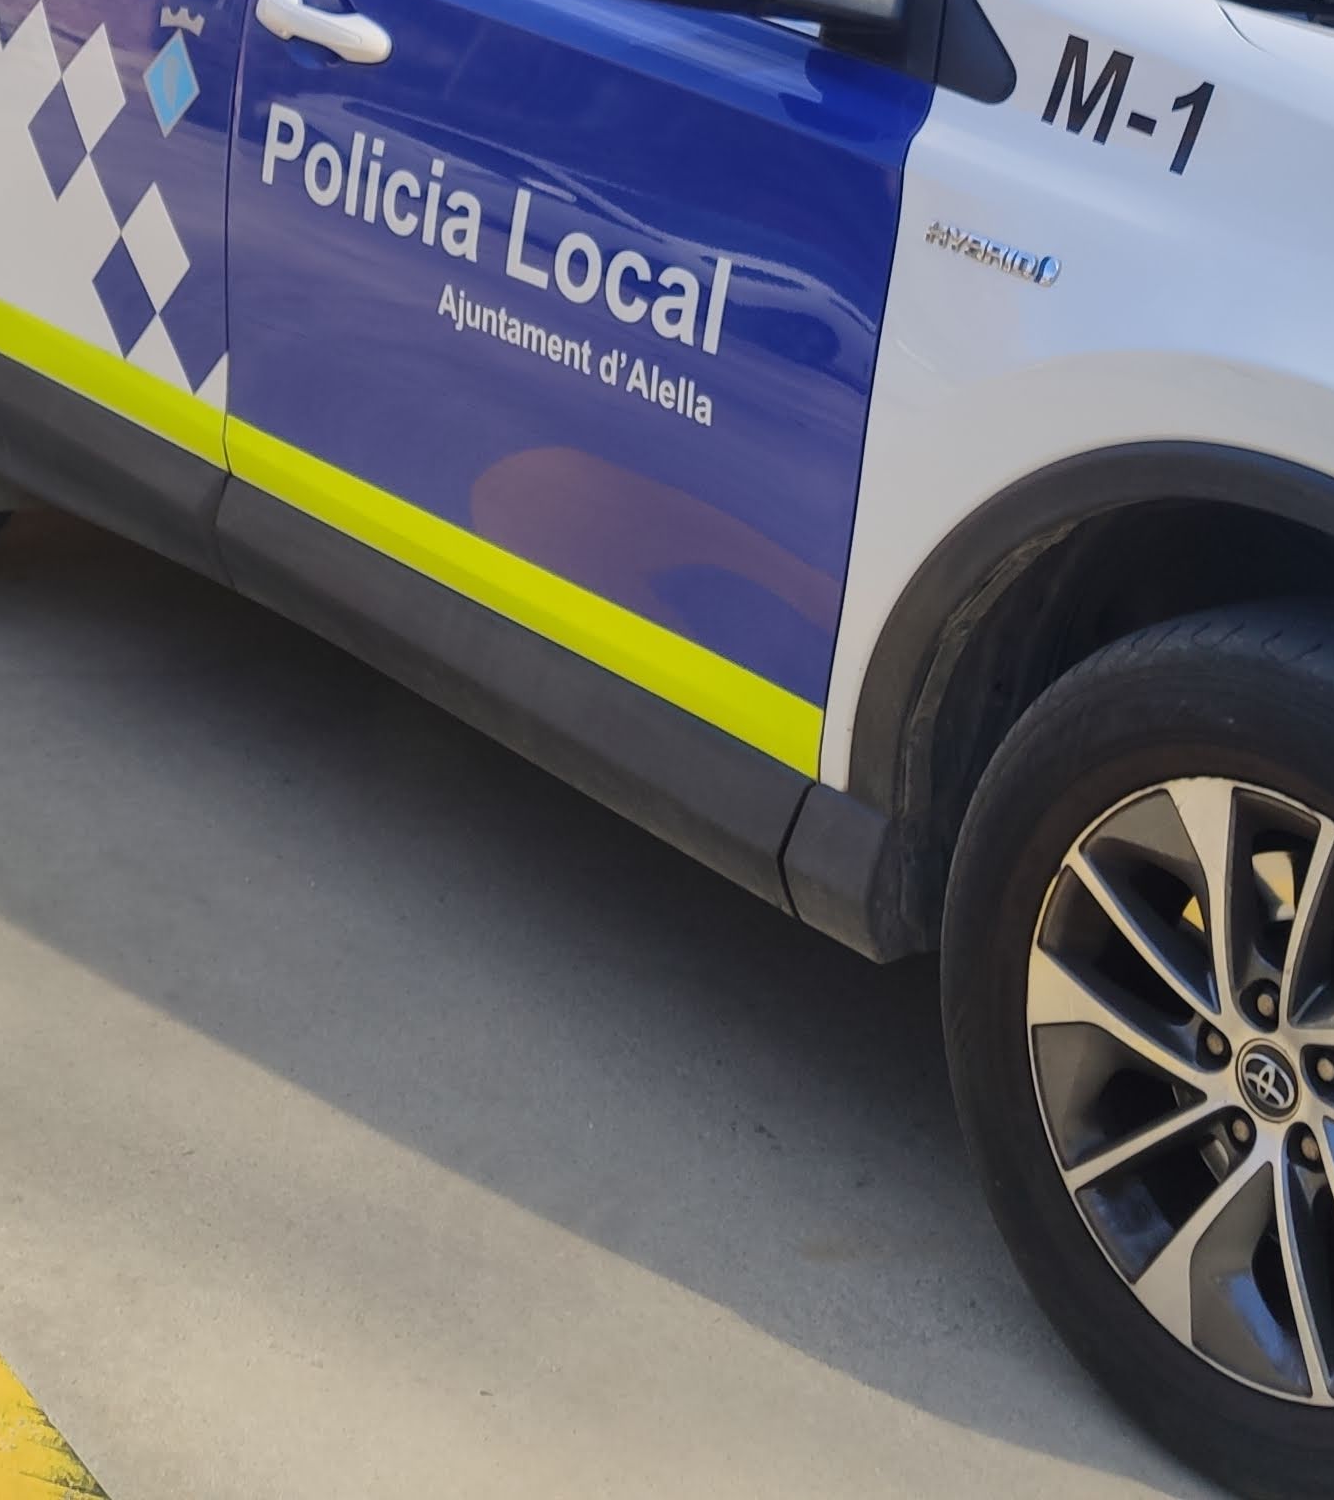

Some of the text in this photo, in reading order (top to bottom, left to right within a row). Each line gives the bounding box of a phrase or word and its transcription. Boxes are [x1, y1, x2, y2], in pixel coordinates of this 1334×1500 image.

[1041, 34, 1215, 176] M-1
[262, 103, 732, 355] Policia Local
[925, 220, 1039, 281] HYBRID
[437, 284, 591, 374] Ajuntament
